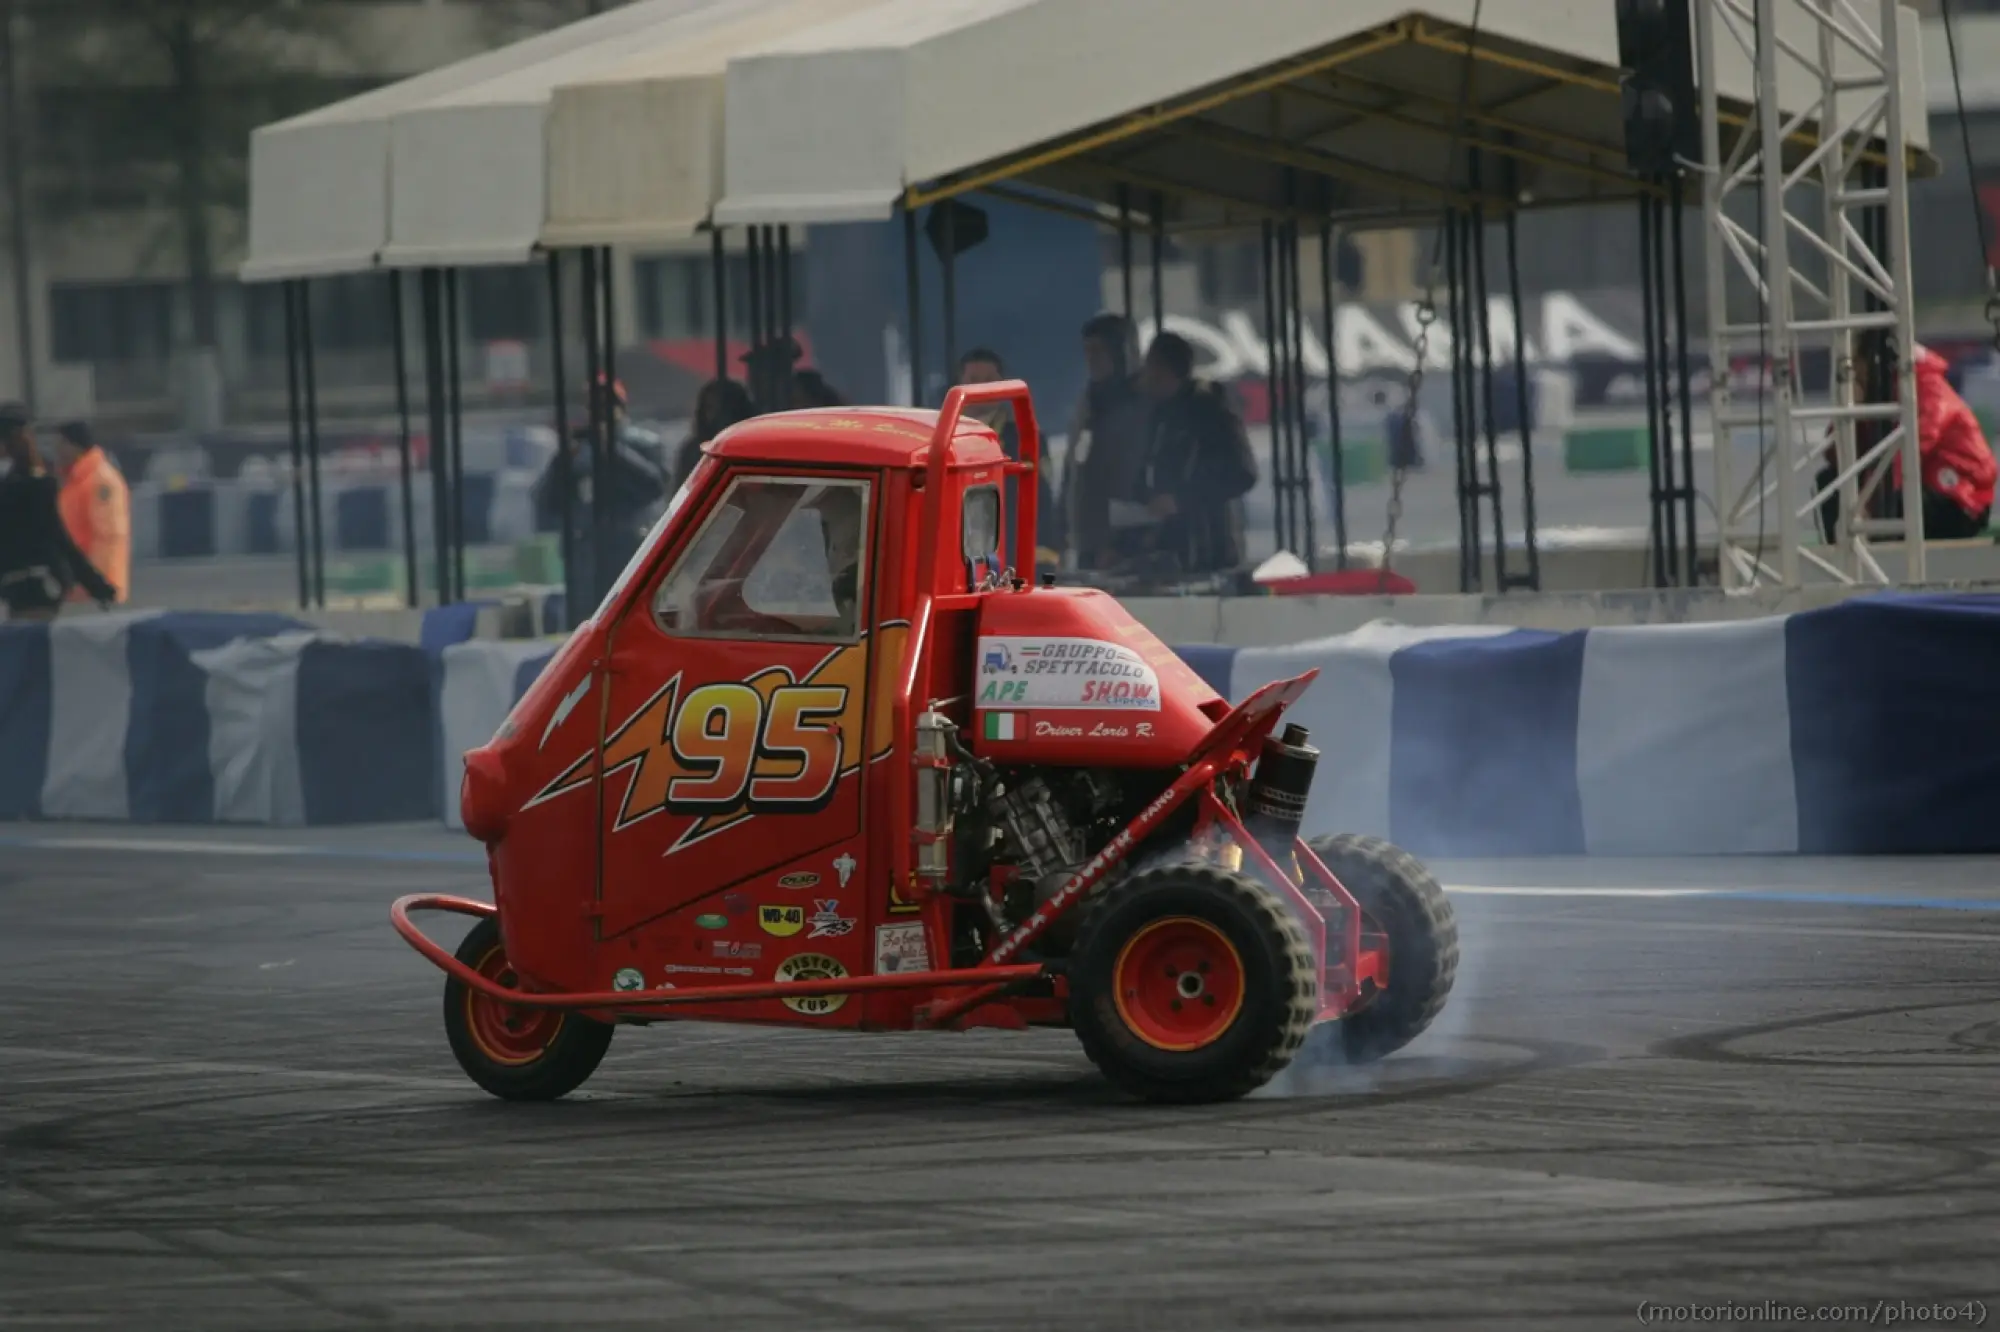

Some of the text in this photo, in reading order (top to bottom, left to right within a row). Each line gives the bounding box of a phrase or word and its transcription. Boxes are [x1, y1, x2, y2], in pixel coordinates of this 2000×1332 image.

[1042, 644, 1116, 660] GRUPPO
[1024, 659, 1144, 679] SPETTACOLO
[981, 680, 1153, 704] APE SHOW
[1035, 720, 1156, 738] Driver Loris R.
[666, 683, 848, 814] 95
[1052, 828, 1134, 908] POWER
[763, 907, 801, 924] WD-40
[782, 955, 844, 977] PISTON
[798, 998, 829, 1011] CUP
